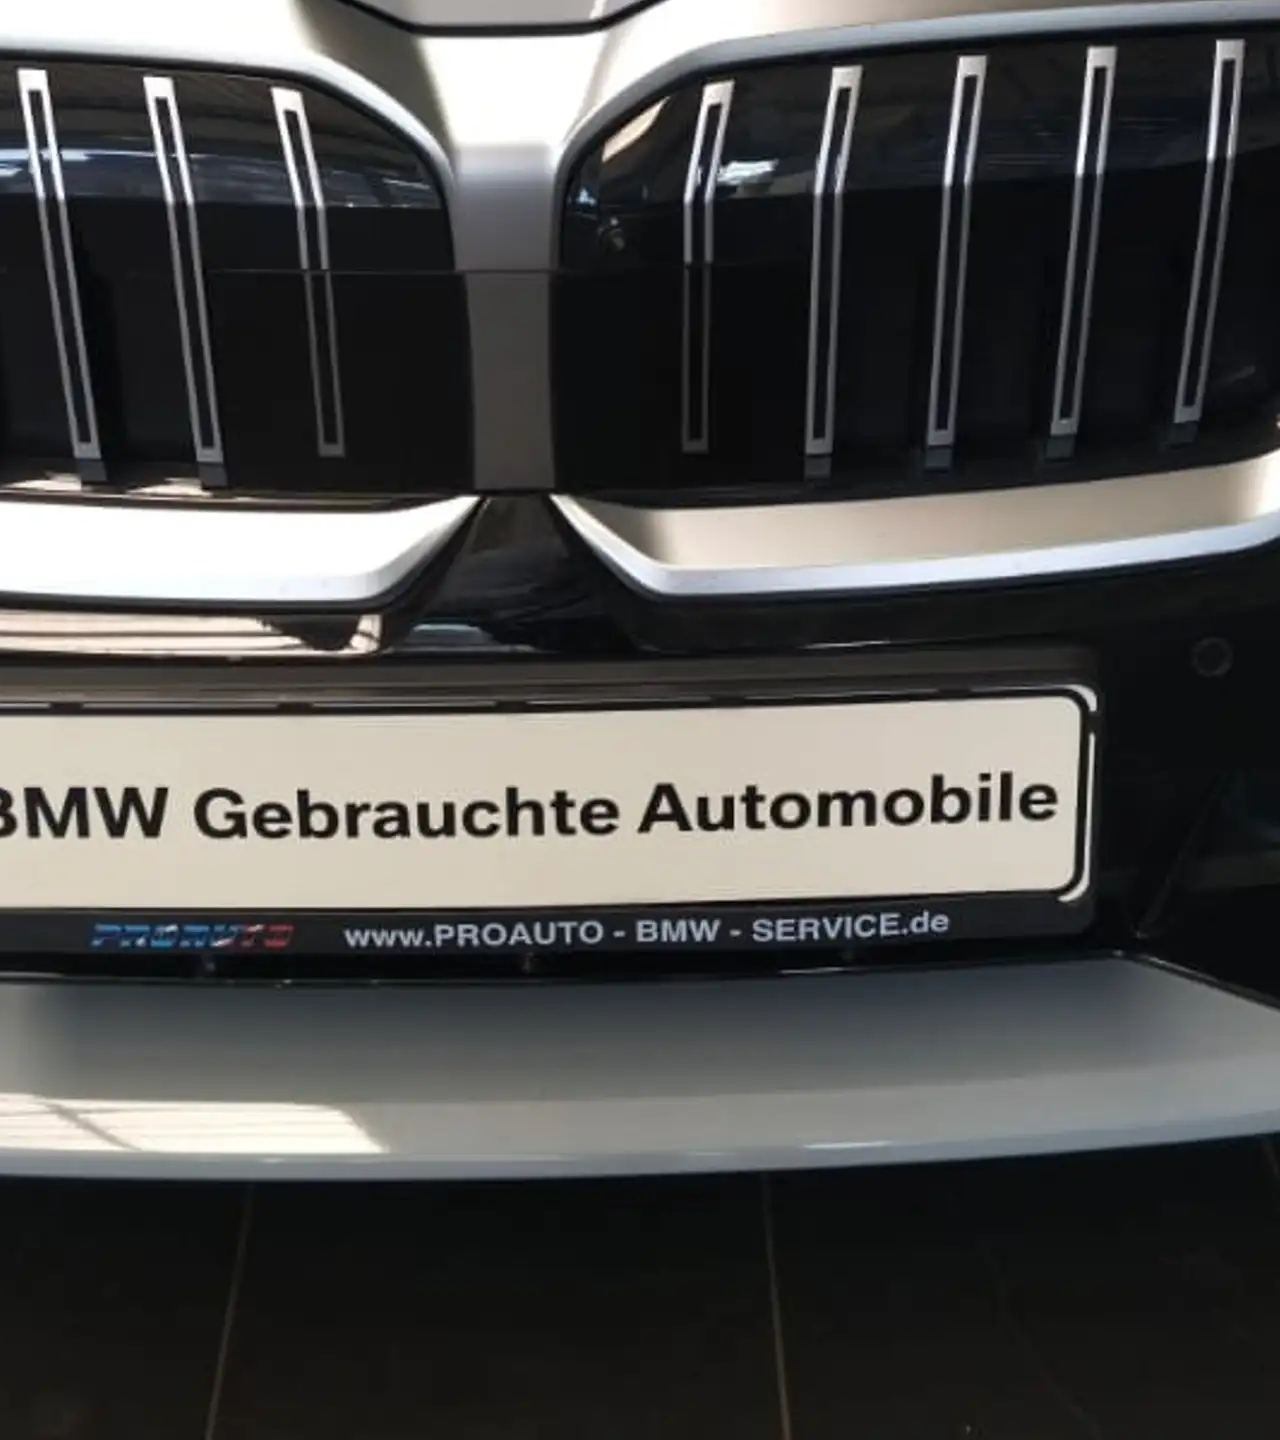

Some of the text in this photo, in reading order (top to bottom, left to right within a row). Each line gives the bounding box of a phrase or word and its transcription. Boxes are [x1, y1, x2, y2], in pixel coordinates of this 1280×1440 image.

[193, 786, 620, 839] Gebrauchte
[636, 770, 1060, 835] Automobile
[343, 919, 604, 948] www.PROAUTO
[635, 919, 721, 943] BMW
[751, 909, 950, 942] SERVICE.de
